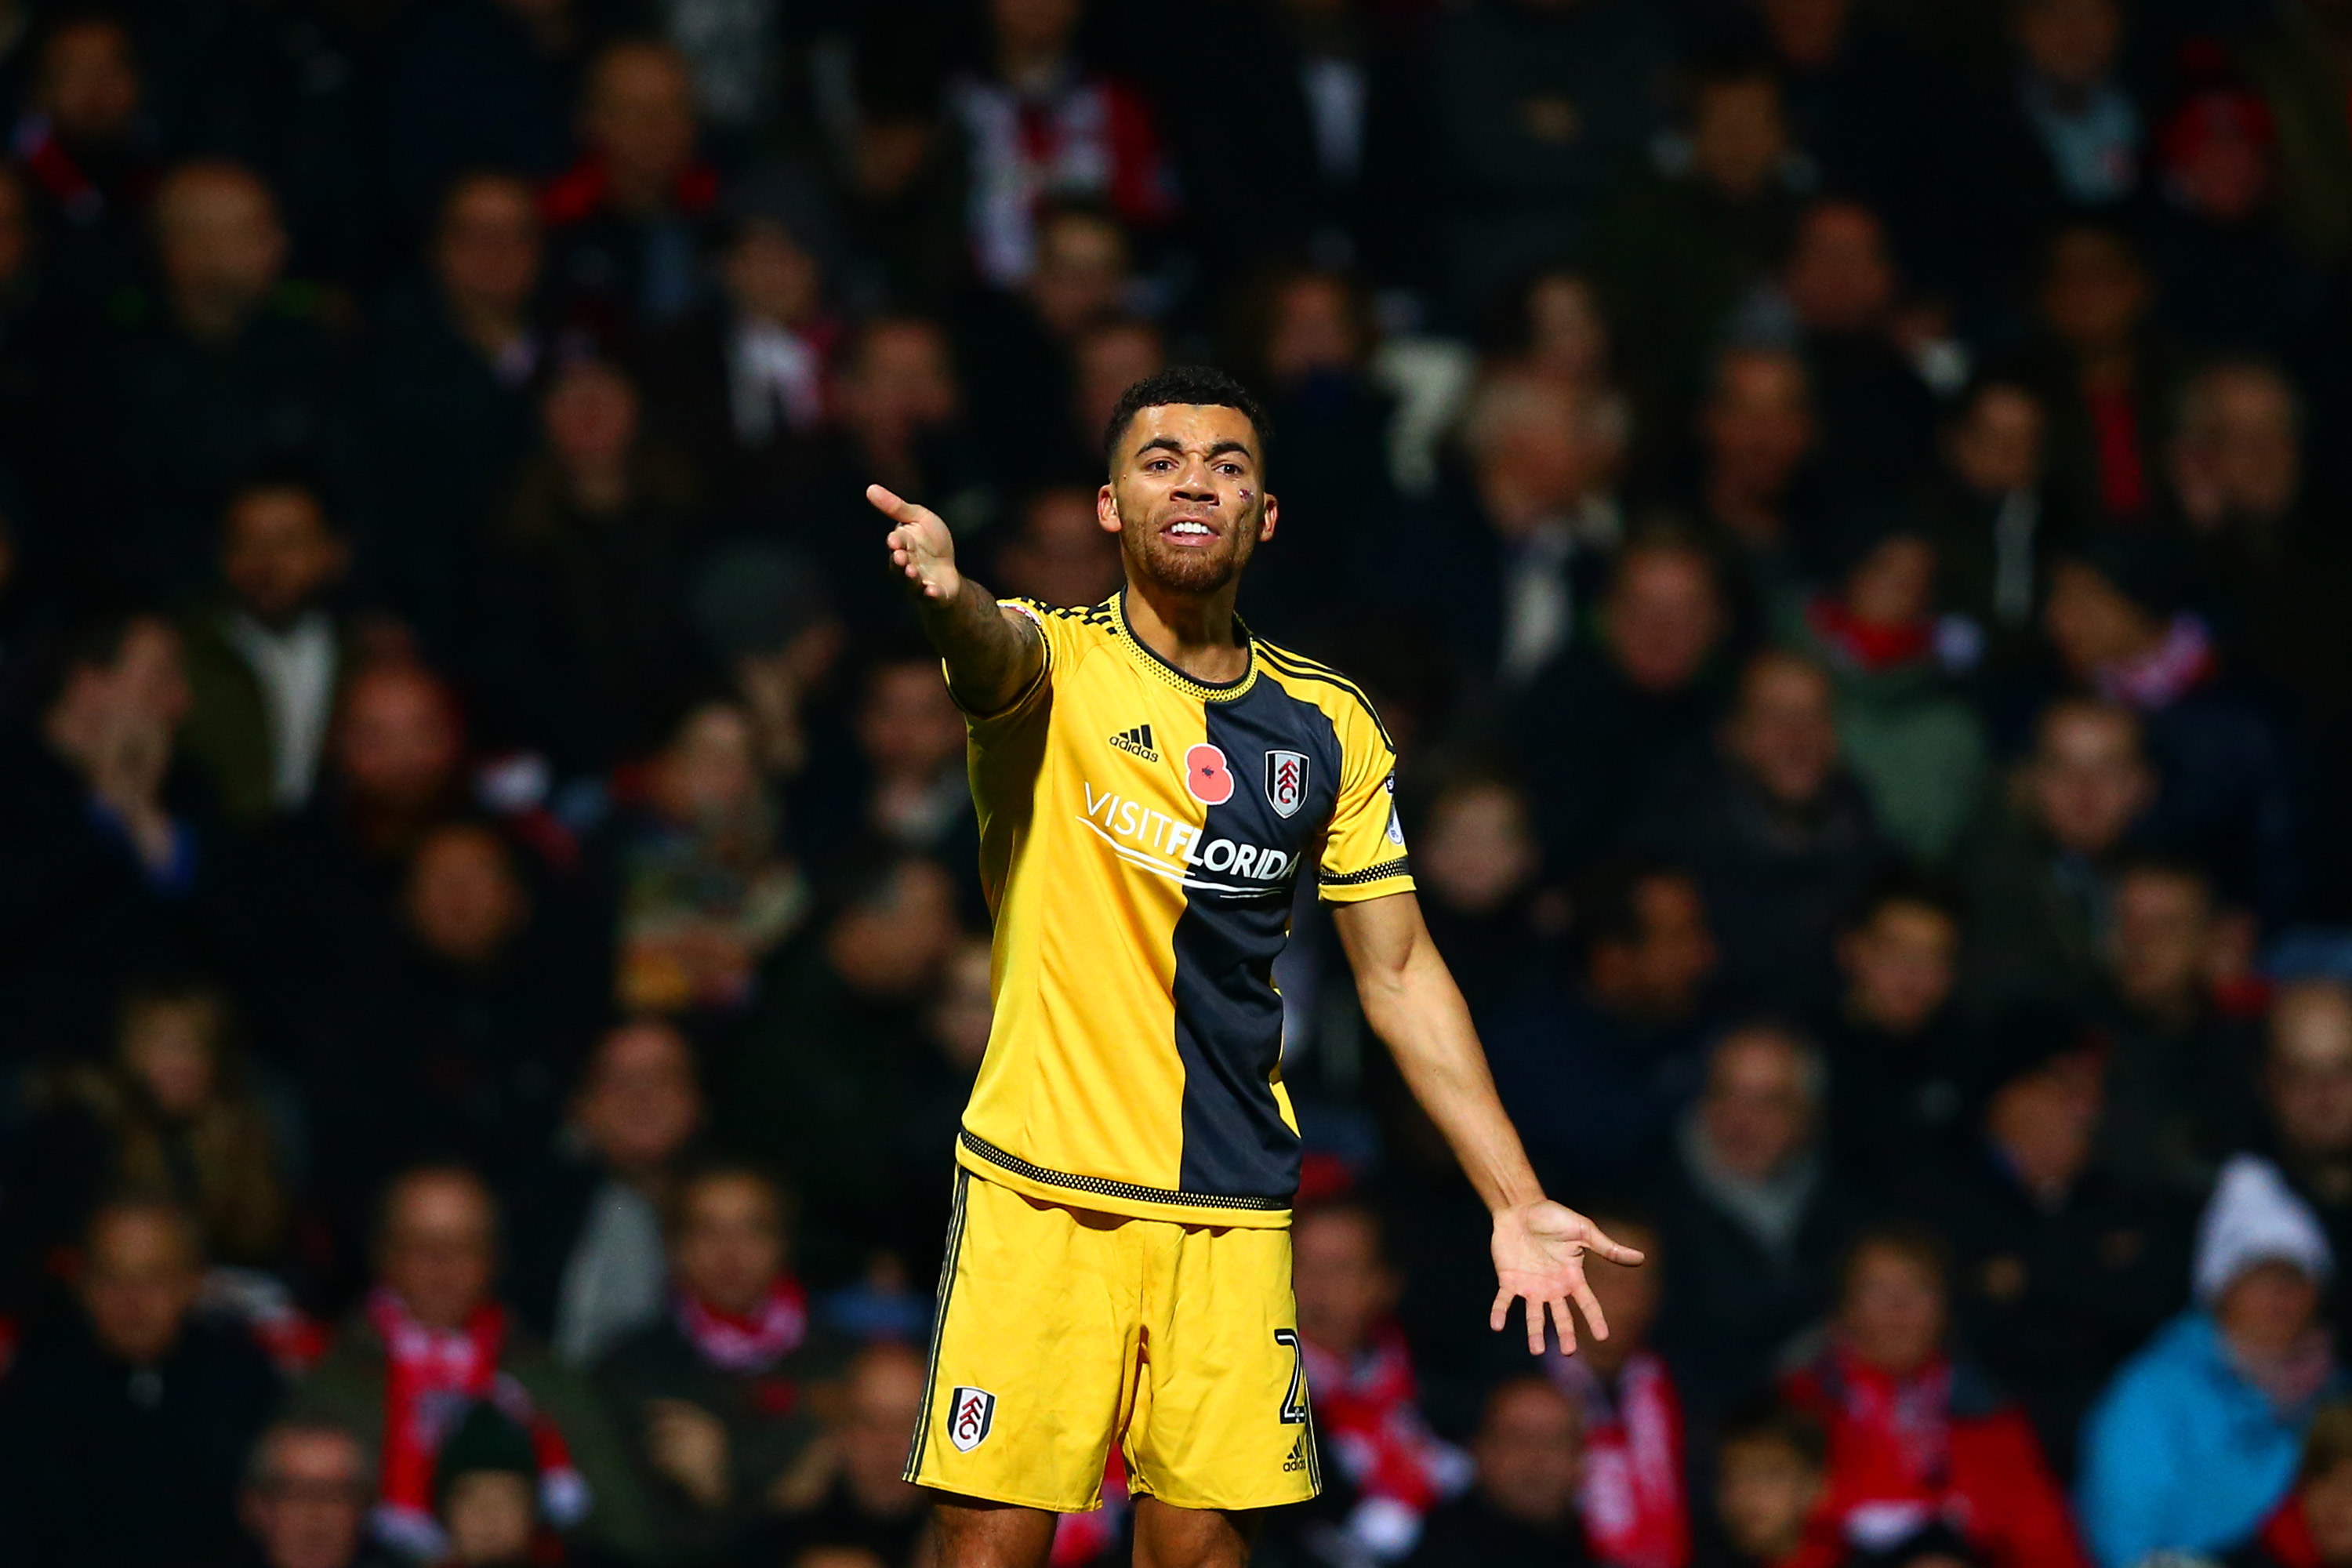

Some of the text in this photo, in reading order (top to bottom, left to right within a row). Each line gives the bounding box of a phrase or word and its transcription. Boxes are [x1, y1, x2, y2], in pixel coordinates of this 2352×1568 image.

[1109, 735, 1159, 763] adidas
[1277, 759, 1298, 804] FFC
[959, 1396, 983, 1440] FFC
